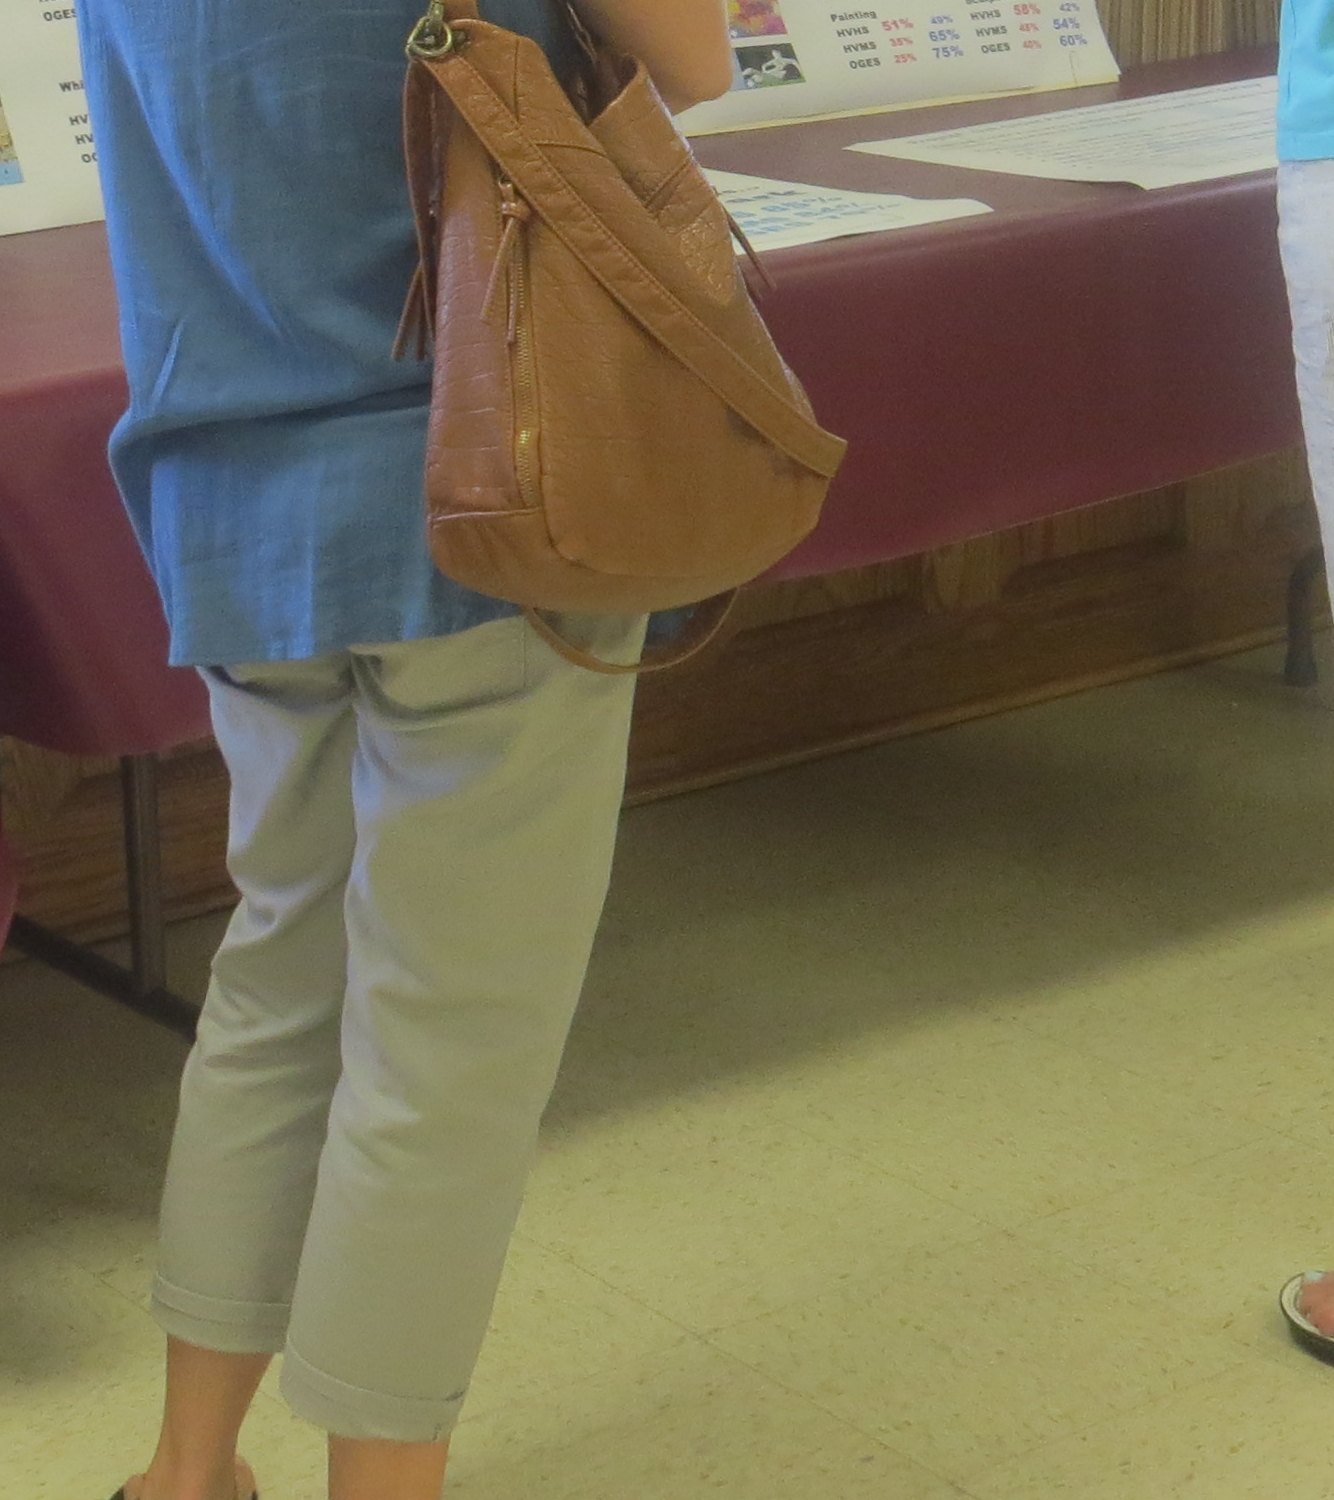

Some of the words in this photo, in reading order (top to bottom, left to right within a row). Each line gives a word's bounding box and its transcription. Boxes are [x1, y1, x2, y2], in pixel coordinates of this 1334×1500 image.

[830, 10, 877, 22] Painting
[970, 9, 1001, 21] HVHS
[837, 26, 869, 38] HVHS
[881, 18, 914, 31] 51%
[976, 25, 1007, 38] HVMS
[1053, 18, 1080, 30] 54%
[843, 41, 876, 53] HVMS
[929, 29, 960, 42] 65%
[981, 42, 1010, 54] OGES
[1060, 34, 1087, 46] 60%
[849, 57, 881, 70] OGES
[932, 46, 963, 59] 75%
